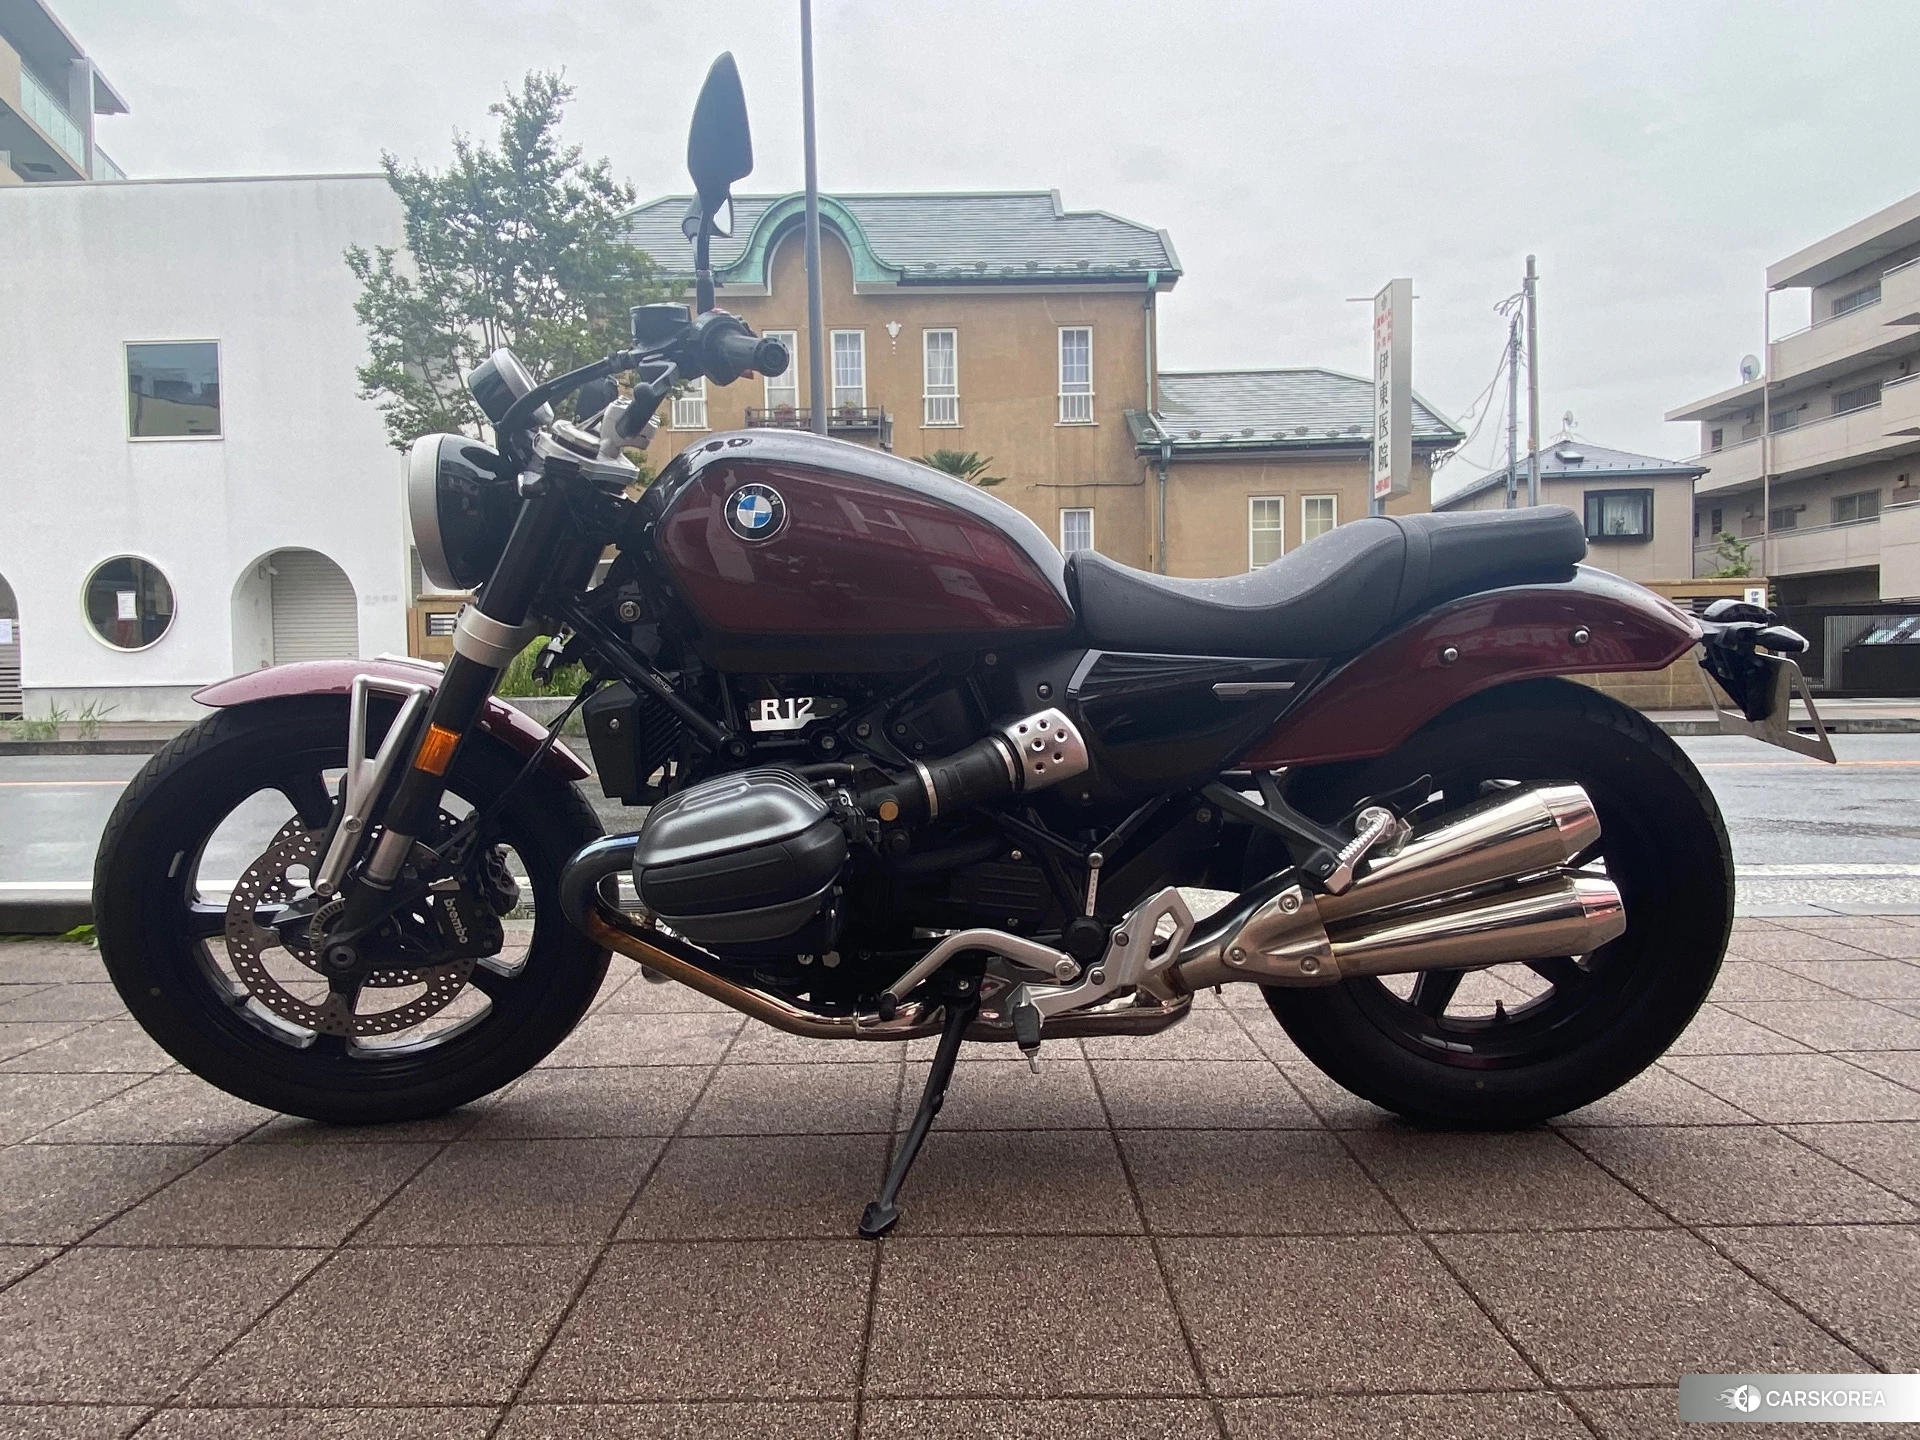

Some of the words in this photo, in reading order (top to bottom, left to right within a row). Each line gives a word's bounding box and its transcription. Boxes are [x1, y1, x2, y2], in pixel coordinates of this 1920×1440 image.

[1378, 350, 1390, 473] 伊東医院
[734, 486, 781, 506] BMW
[443, 897, 469, 944] brembo
